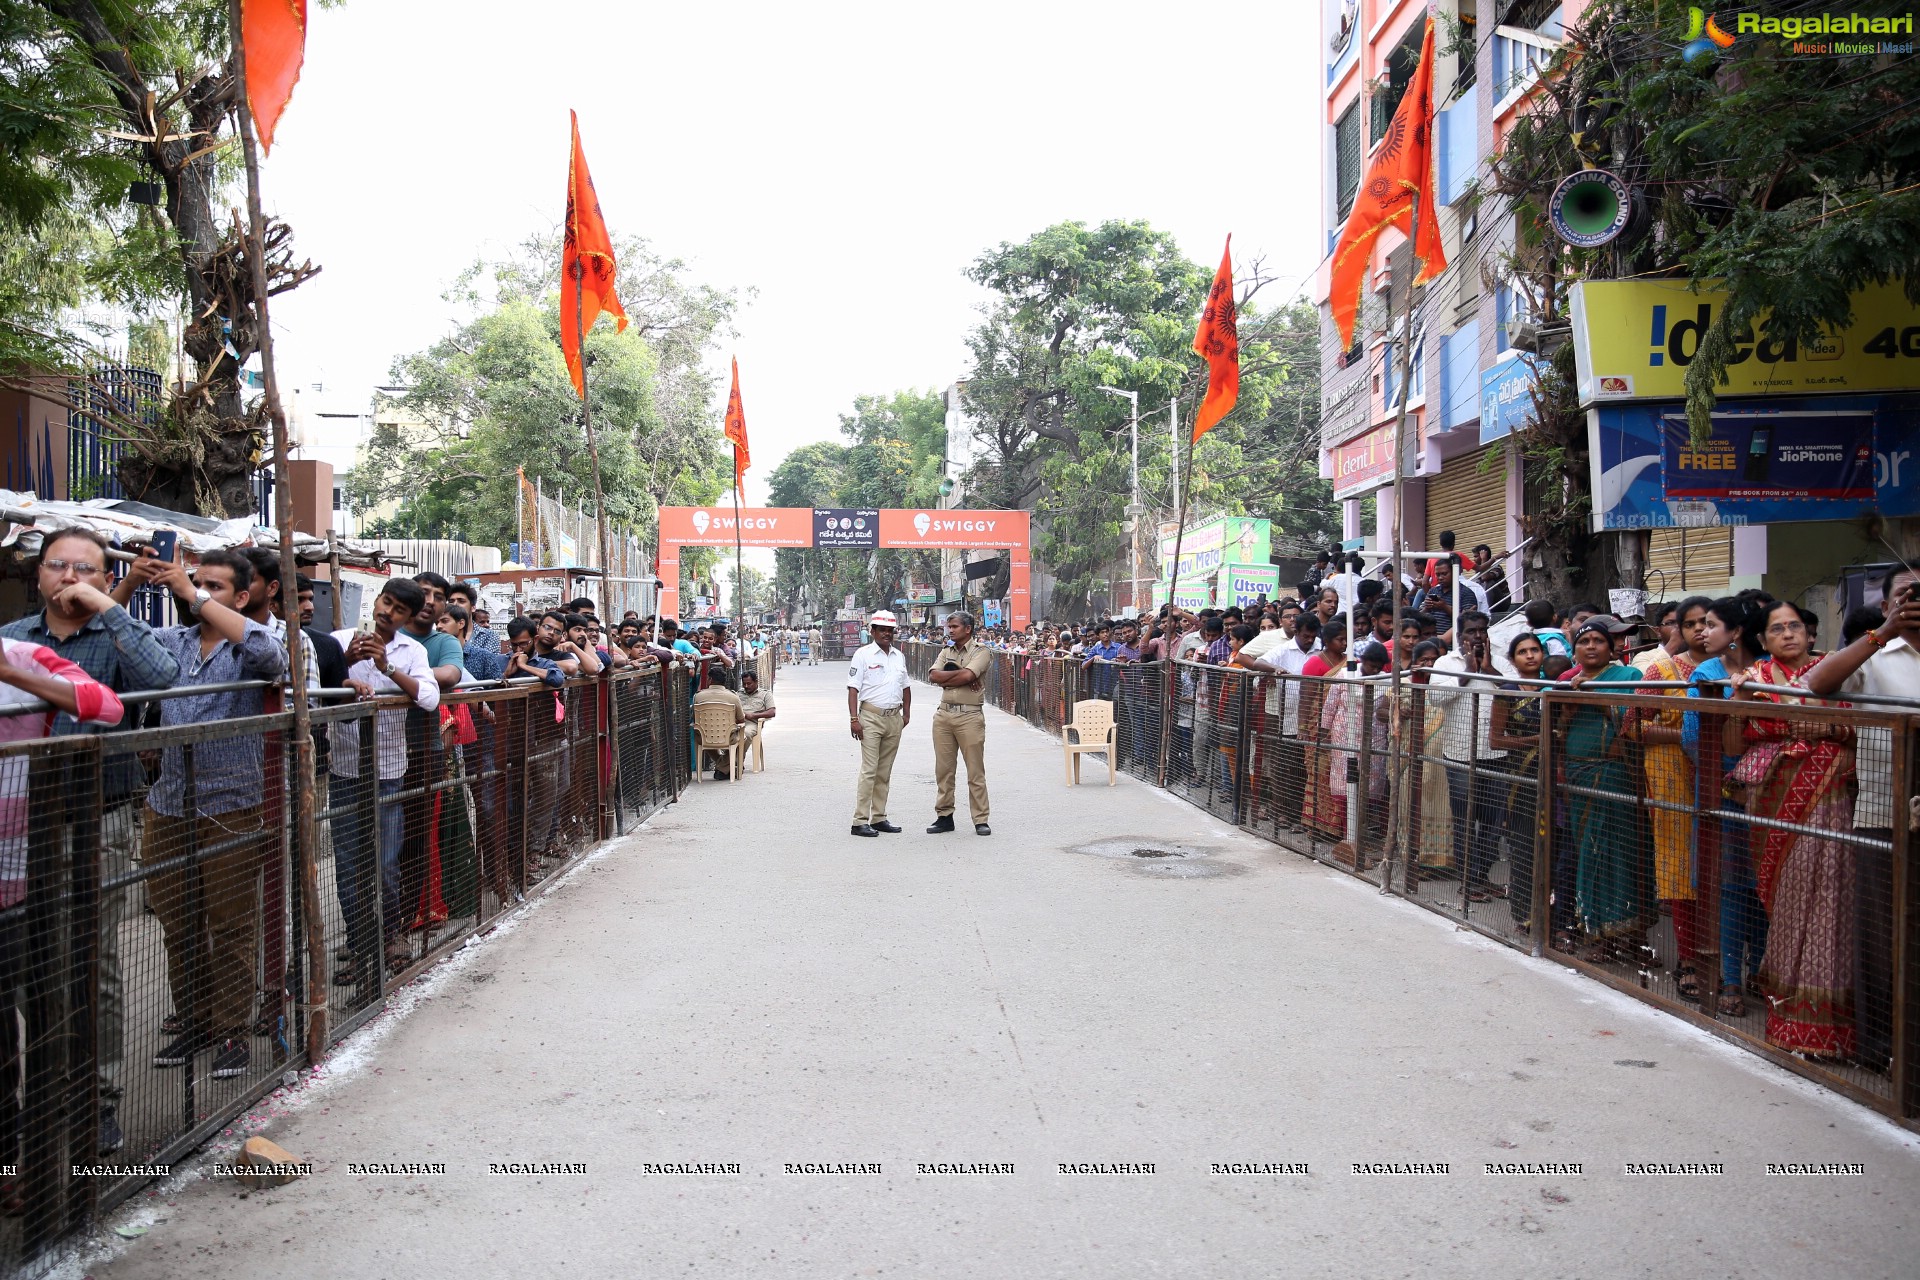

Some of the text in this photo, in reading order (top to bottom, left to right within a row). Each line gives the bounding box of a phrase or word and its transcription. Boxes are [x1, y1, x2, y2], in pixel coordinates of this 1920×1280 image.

[1552, 173, 1628, 226] SANJANA SOUND
[1679, 453, 1737, 470] FREE
[1779, 450, 1843, 462] JioPhone
[713, 517, 778, 529] SWIGGY
[933, 520, 996, 532] SWIGGY
[1166, 549, 1220, 578] Usav Mela
[1234, 578, 1273, 592] Utsav
